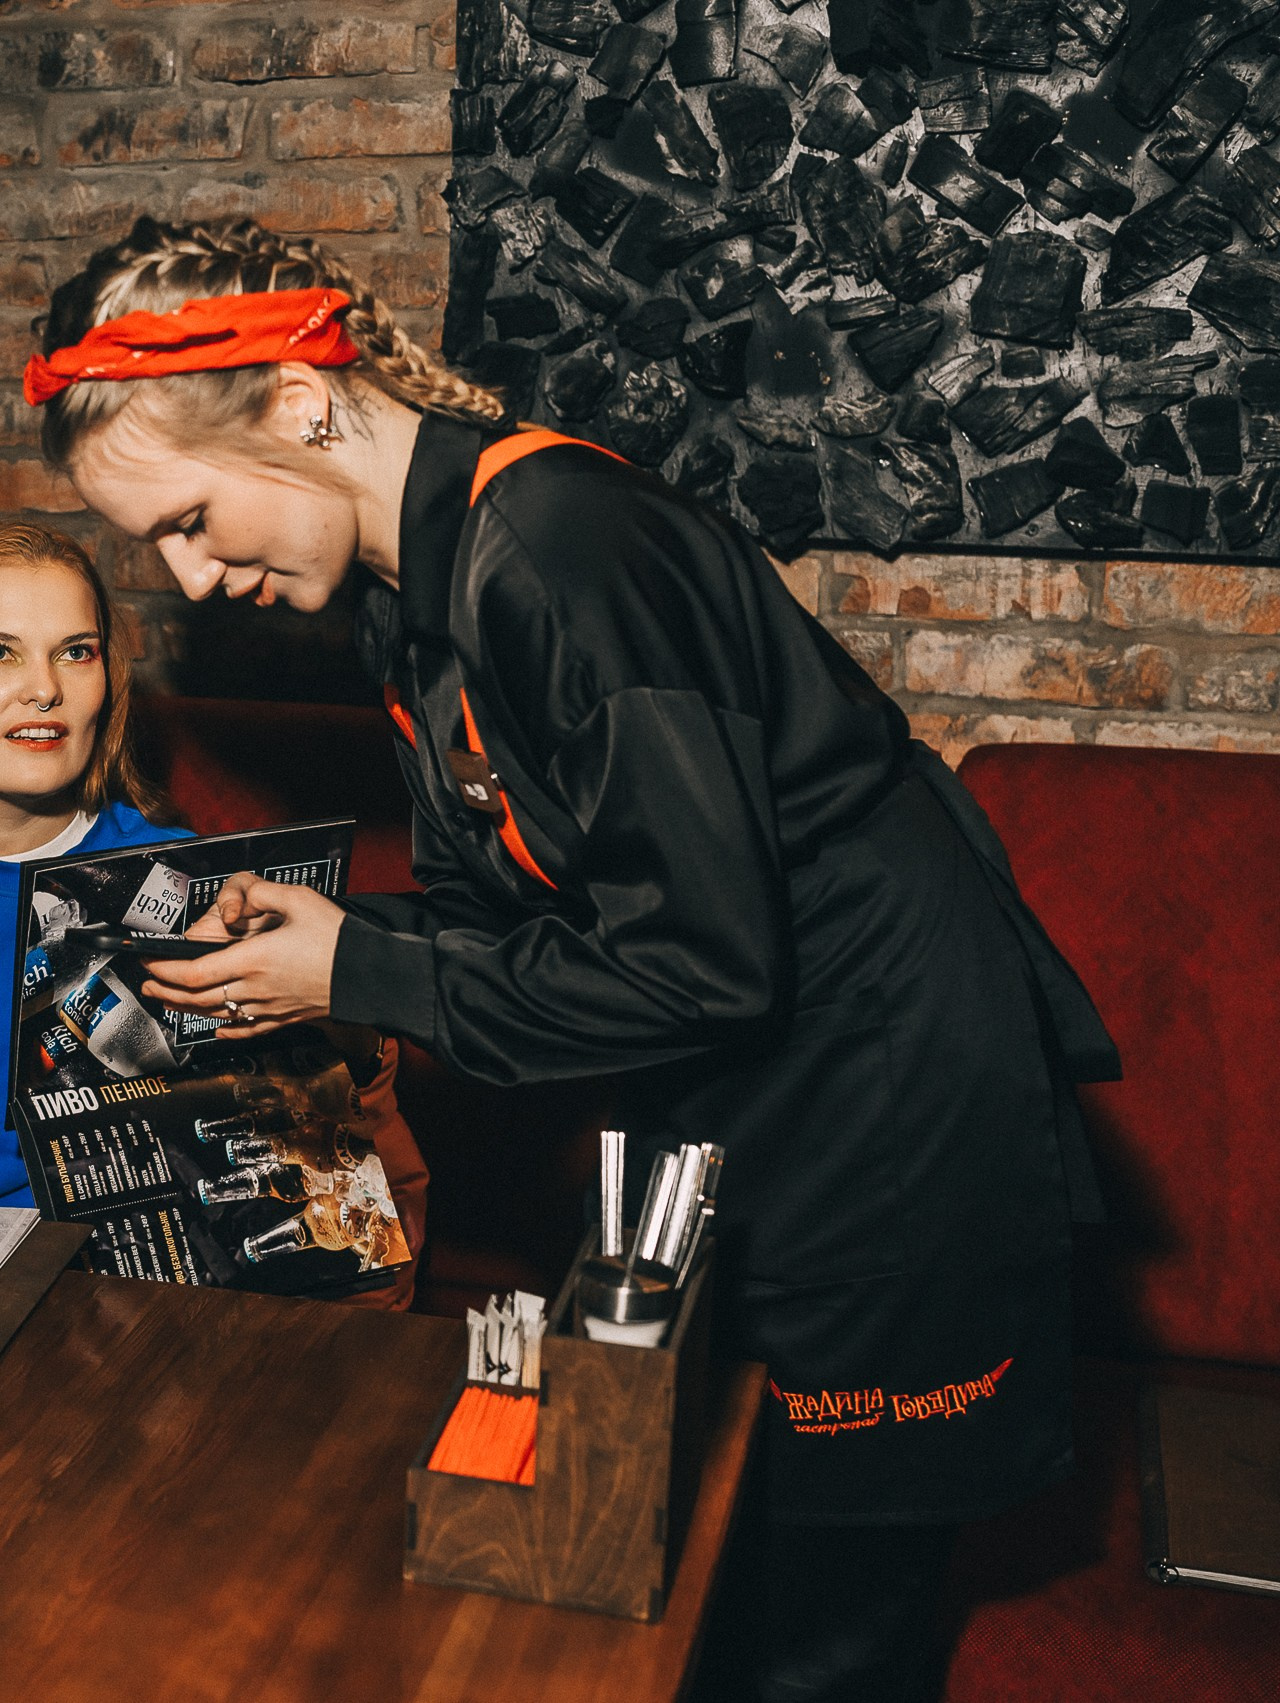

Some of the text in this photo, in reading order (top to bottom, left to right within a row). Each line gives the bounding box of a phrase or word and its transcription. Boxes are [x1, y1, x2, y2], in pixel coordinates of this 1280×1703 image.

[162, 889, 184, 904] cola
[136, 894, 178, 926] Rich
[64, 1002, 84, 1026] tonic
[69, 988, 102, 1026] Rich
[182, 1017, 231, 1034] ЛОДНЫЕ
[41, 1031, 56, 1048] cola
[51, 1024, 78, 1053] Rich
[30, 1076, 172, 1120] ПИВО ПЕННОЕ
[49, 1139, 75, 1202] ПИВО БУТЫЛОЧНОЕ
[140, 1169, 150, 1186] SPATEN
[92, 1179, 102, 1196] STELLA
[113, 1249, 121, 1260] BIER
[130, 1245, 138, 1255] BIER
[158, 1209, 185, 1284] ИВО БЕЗАЛКОГОЛЬНОЕ
[189, 1269, 198, 1285] STELLA
[782, 1374, 996, 1422] ЖАДИНА ГОВЯДИНА
[794, 1412, 885, 1436] гастропаб
